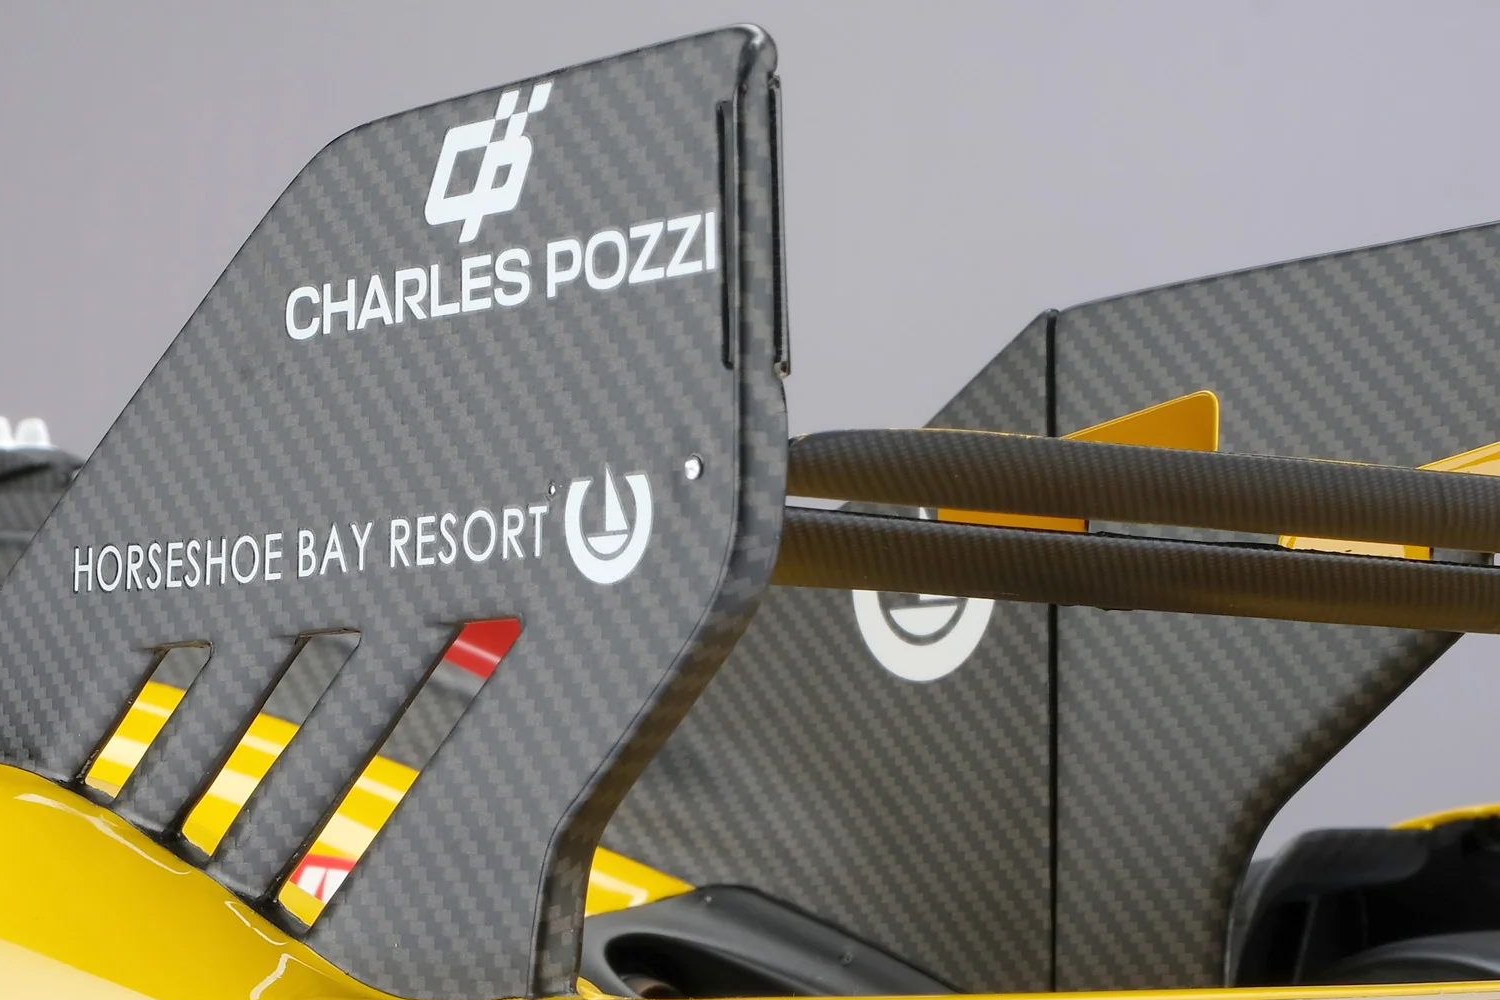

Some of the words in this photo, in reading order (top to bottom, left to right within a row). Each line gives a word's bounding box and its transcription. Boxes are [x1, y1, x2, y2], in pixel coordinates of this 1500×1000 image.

[285, 248, 532, 341] CHARLES
[546, 210, 717, 299] POZZI
[72, 530, 283, 594] HORSESHOE
[297, 520, 374, 578] BAY
[389, 504, 549, 568] RESORT
